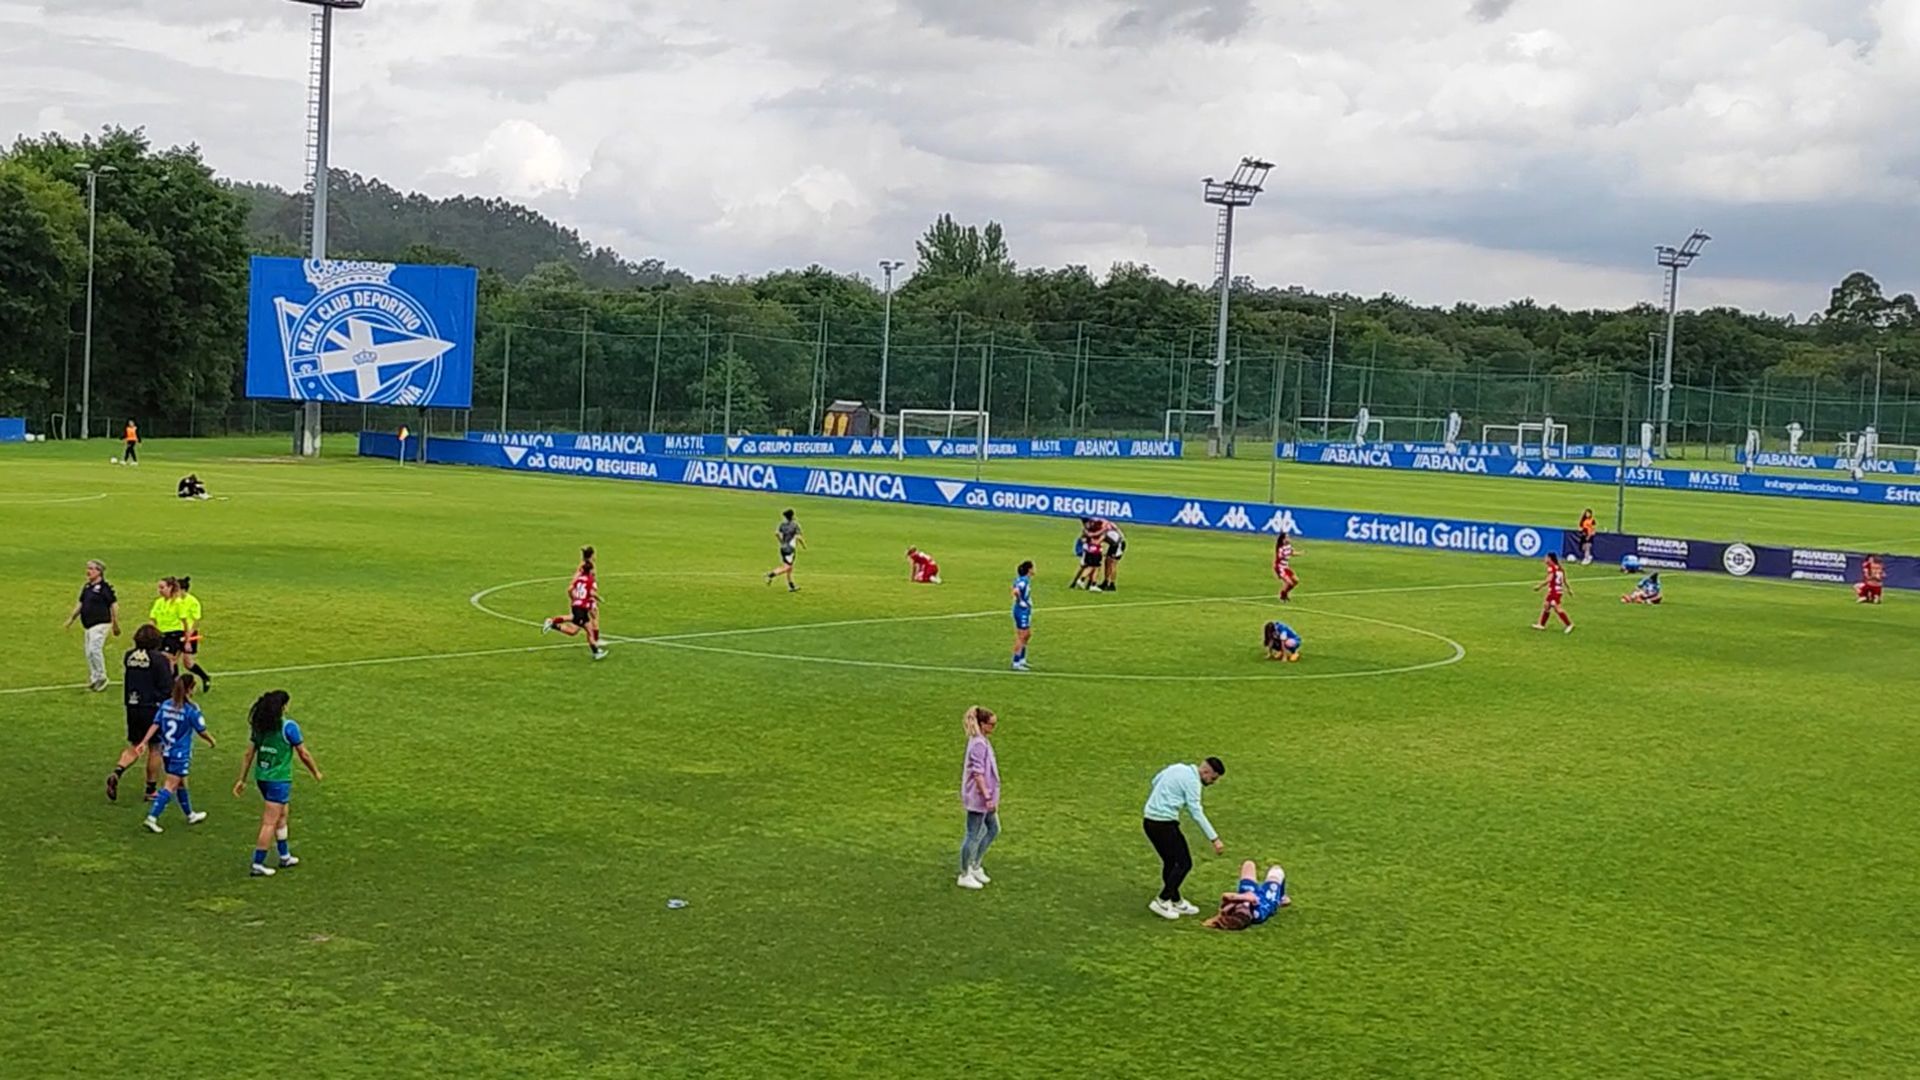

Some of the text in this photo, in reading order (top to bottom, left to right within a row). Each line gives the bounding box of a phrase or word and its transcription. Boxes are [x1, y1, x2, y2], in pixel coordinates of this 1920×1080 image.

[298, 291, 421, 352] REAL CLUB DEPORTIVO
[582, 435, 645, 454] ABANCA
[665, 436, 705, 450] MASTIL
[758, 441, 791, 453] GRUPO
[793, 442, 834, 453] REGUEIRA
[1078, 440, 1120, 456] ABANCA
[1134, 441, 1175, 456] ABANCA
[548, 455, 593, 472] GRUPO
[596, 458, 658, 477] REGUEIRA
[1328, 447, 1392, 467] ABANCA
[1420, 455, 1488, 473] ABANCA
[1761, 453, 1817, 469] ABANCA
[691, 461, 778, 490] ABANCA
[1688, 471, 1740, 486] MASTIL
[814, 471, 907, 500] ABANCA
[992, 491, 1050, 511] GRUPO
[1053, 496, 1133, 518] REGUEIRA
[1345, 515, 1510, 552] Estrella Galicia
[1637, 537, 1688, 550] PRIMERA
[1793, 549, 1847, 562] PRIMERA
[164, 720, 178, 743] 2
